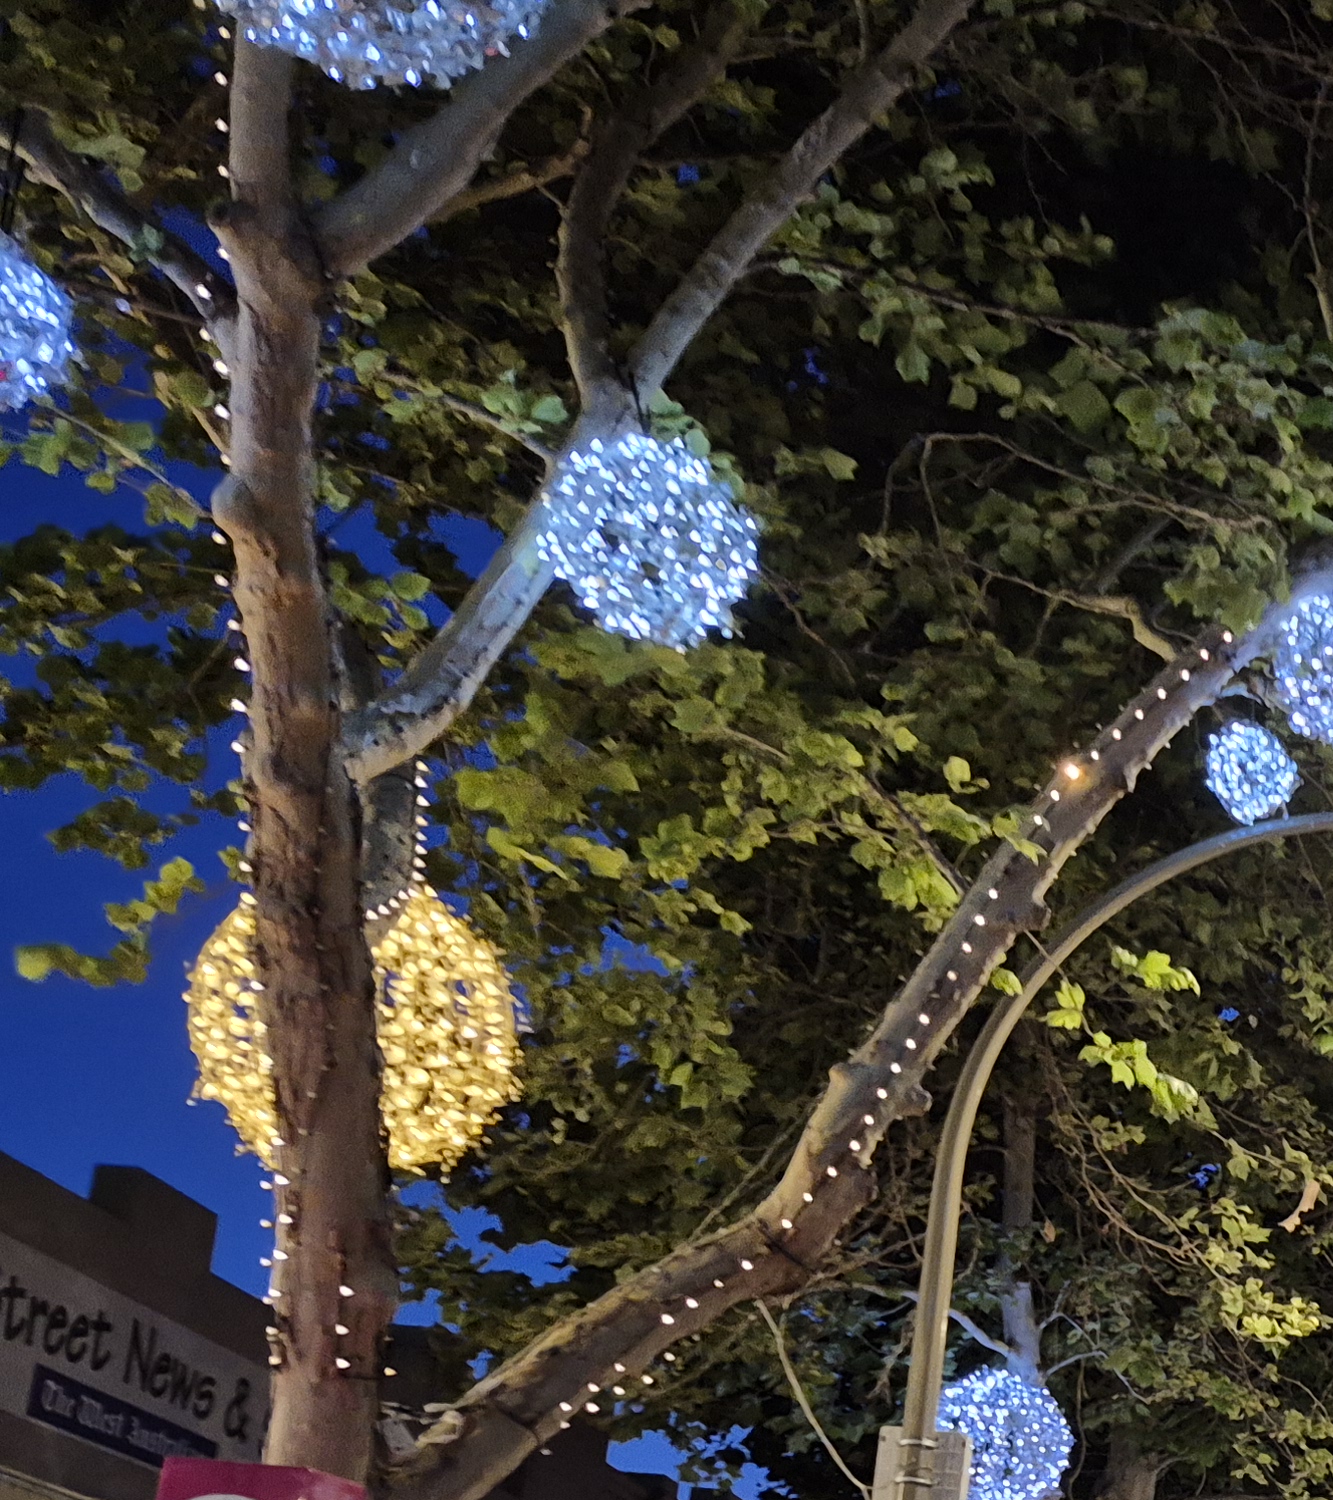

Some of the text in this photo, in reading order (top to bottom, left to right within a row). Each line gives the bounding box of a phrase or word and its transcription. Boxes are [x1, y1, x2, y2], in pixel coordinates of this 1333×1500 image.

[0, 1275, 250, 1442] treet News &
